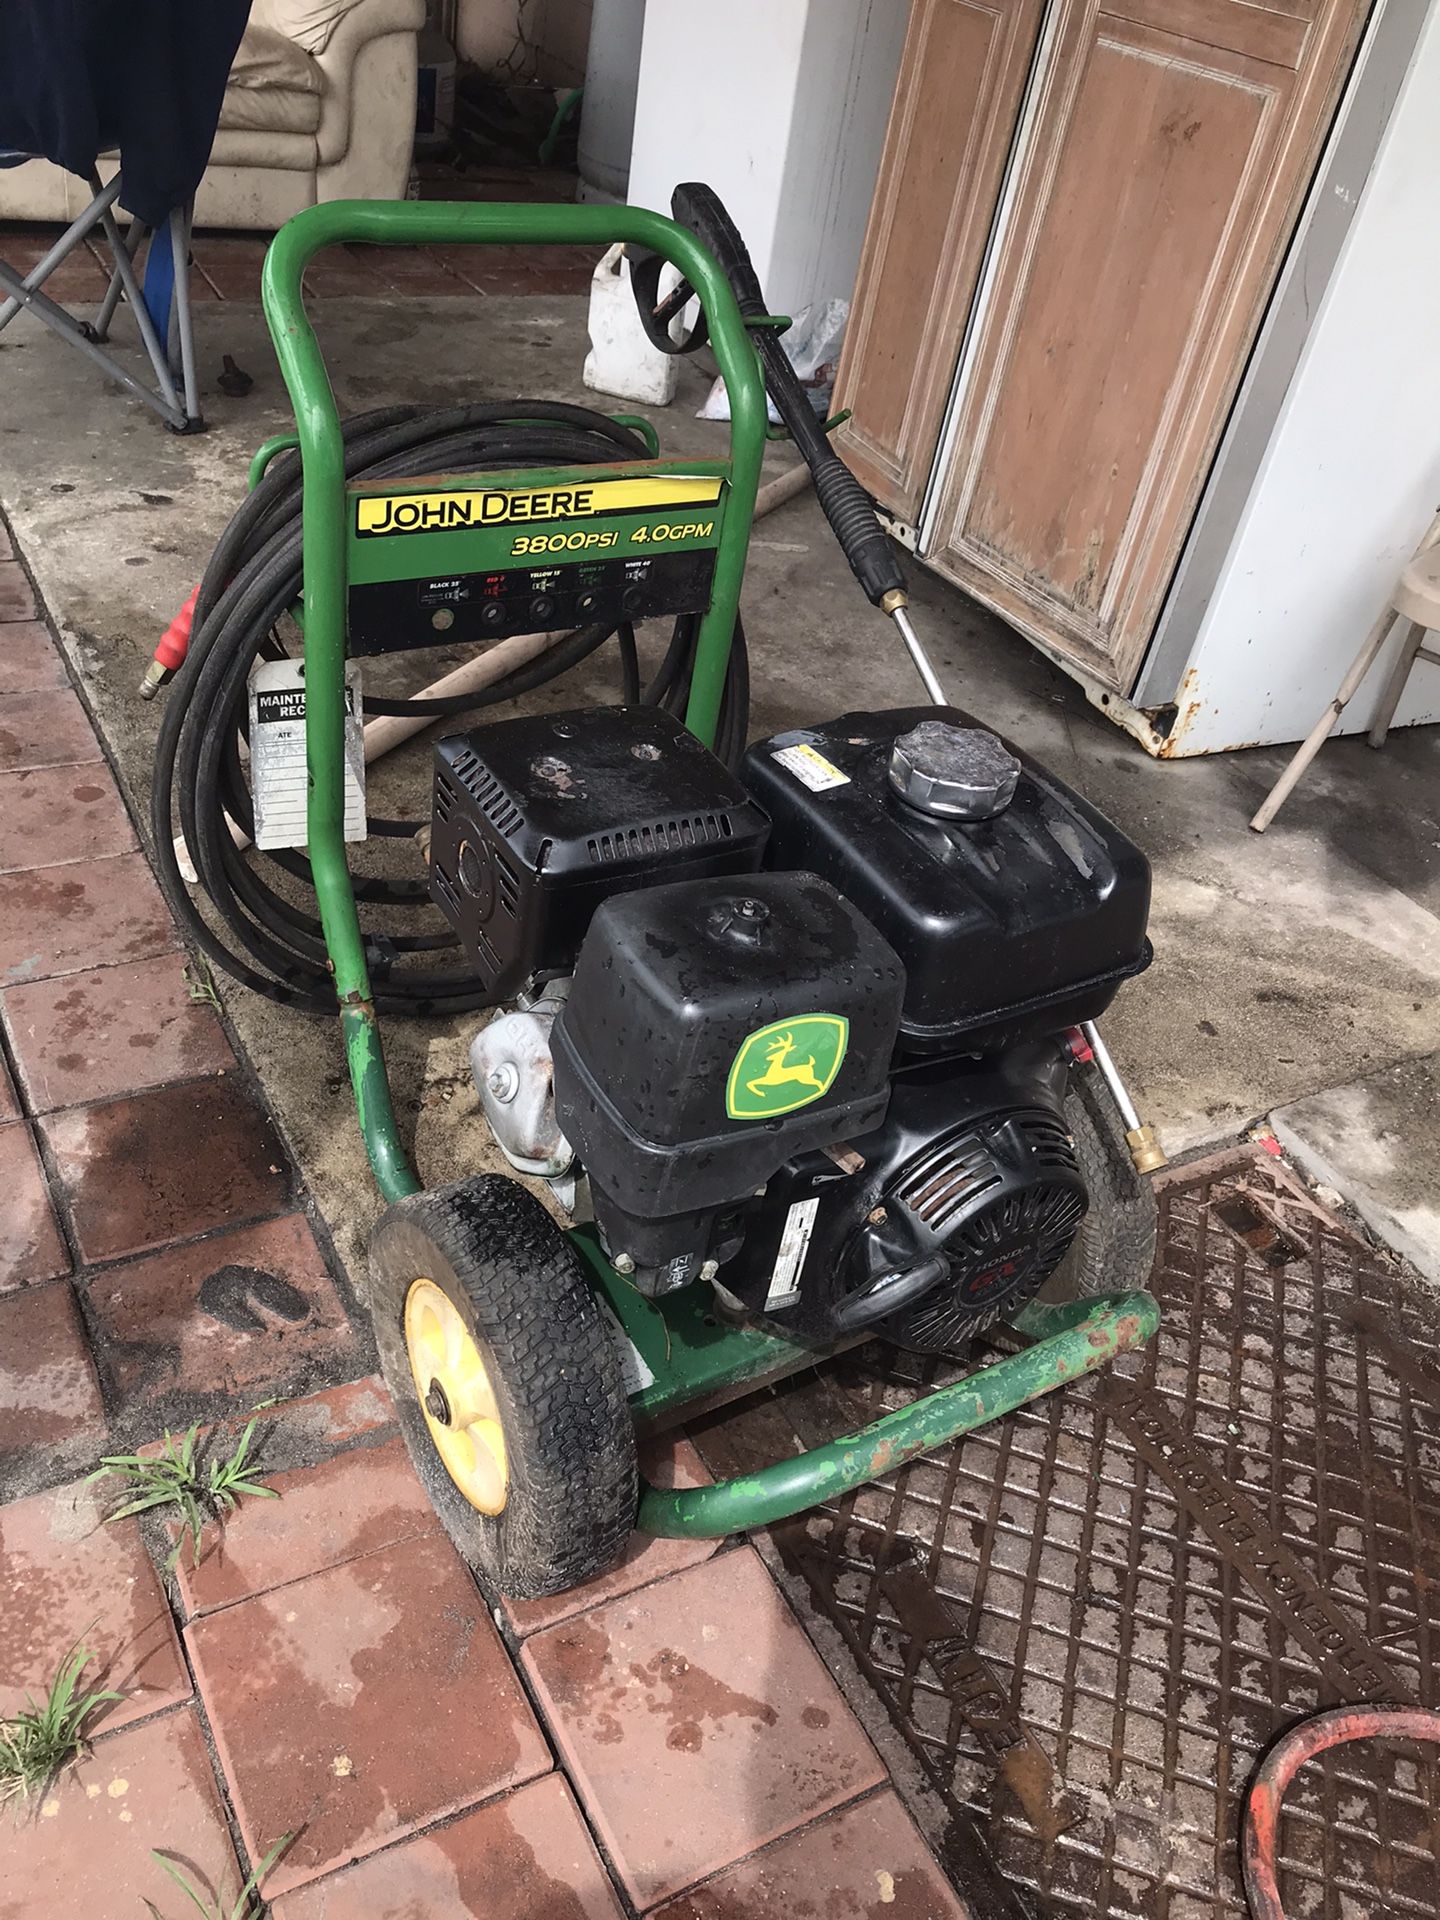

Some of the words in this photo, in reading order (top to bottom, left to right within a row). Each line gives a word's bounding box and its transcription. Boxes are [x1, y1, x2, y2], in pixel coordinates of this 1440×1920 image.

[371, 499, 472, 530] JOHN
[481, 490, 594, 521] DEERE
[511, 530, 619, 557] 3800PSI
[630, 521, 714, 544] 4.0GPM
[429, 581, 450, 589] BLACK
[280, 706, 307, 718] REC
[1253, 1551, 1390, 1700] ERGENCY
